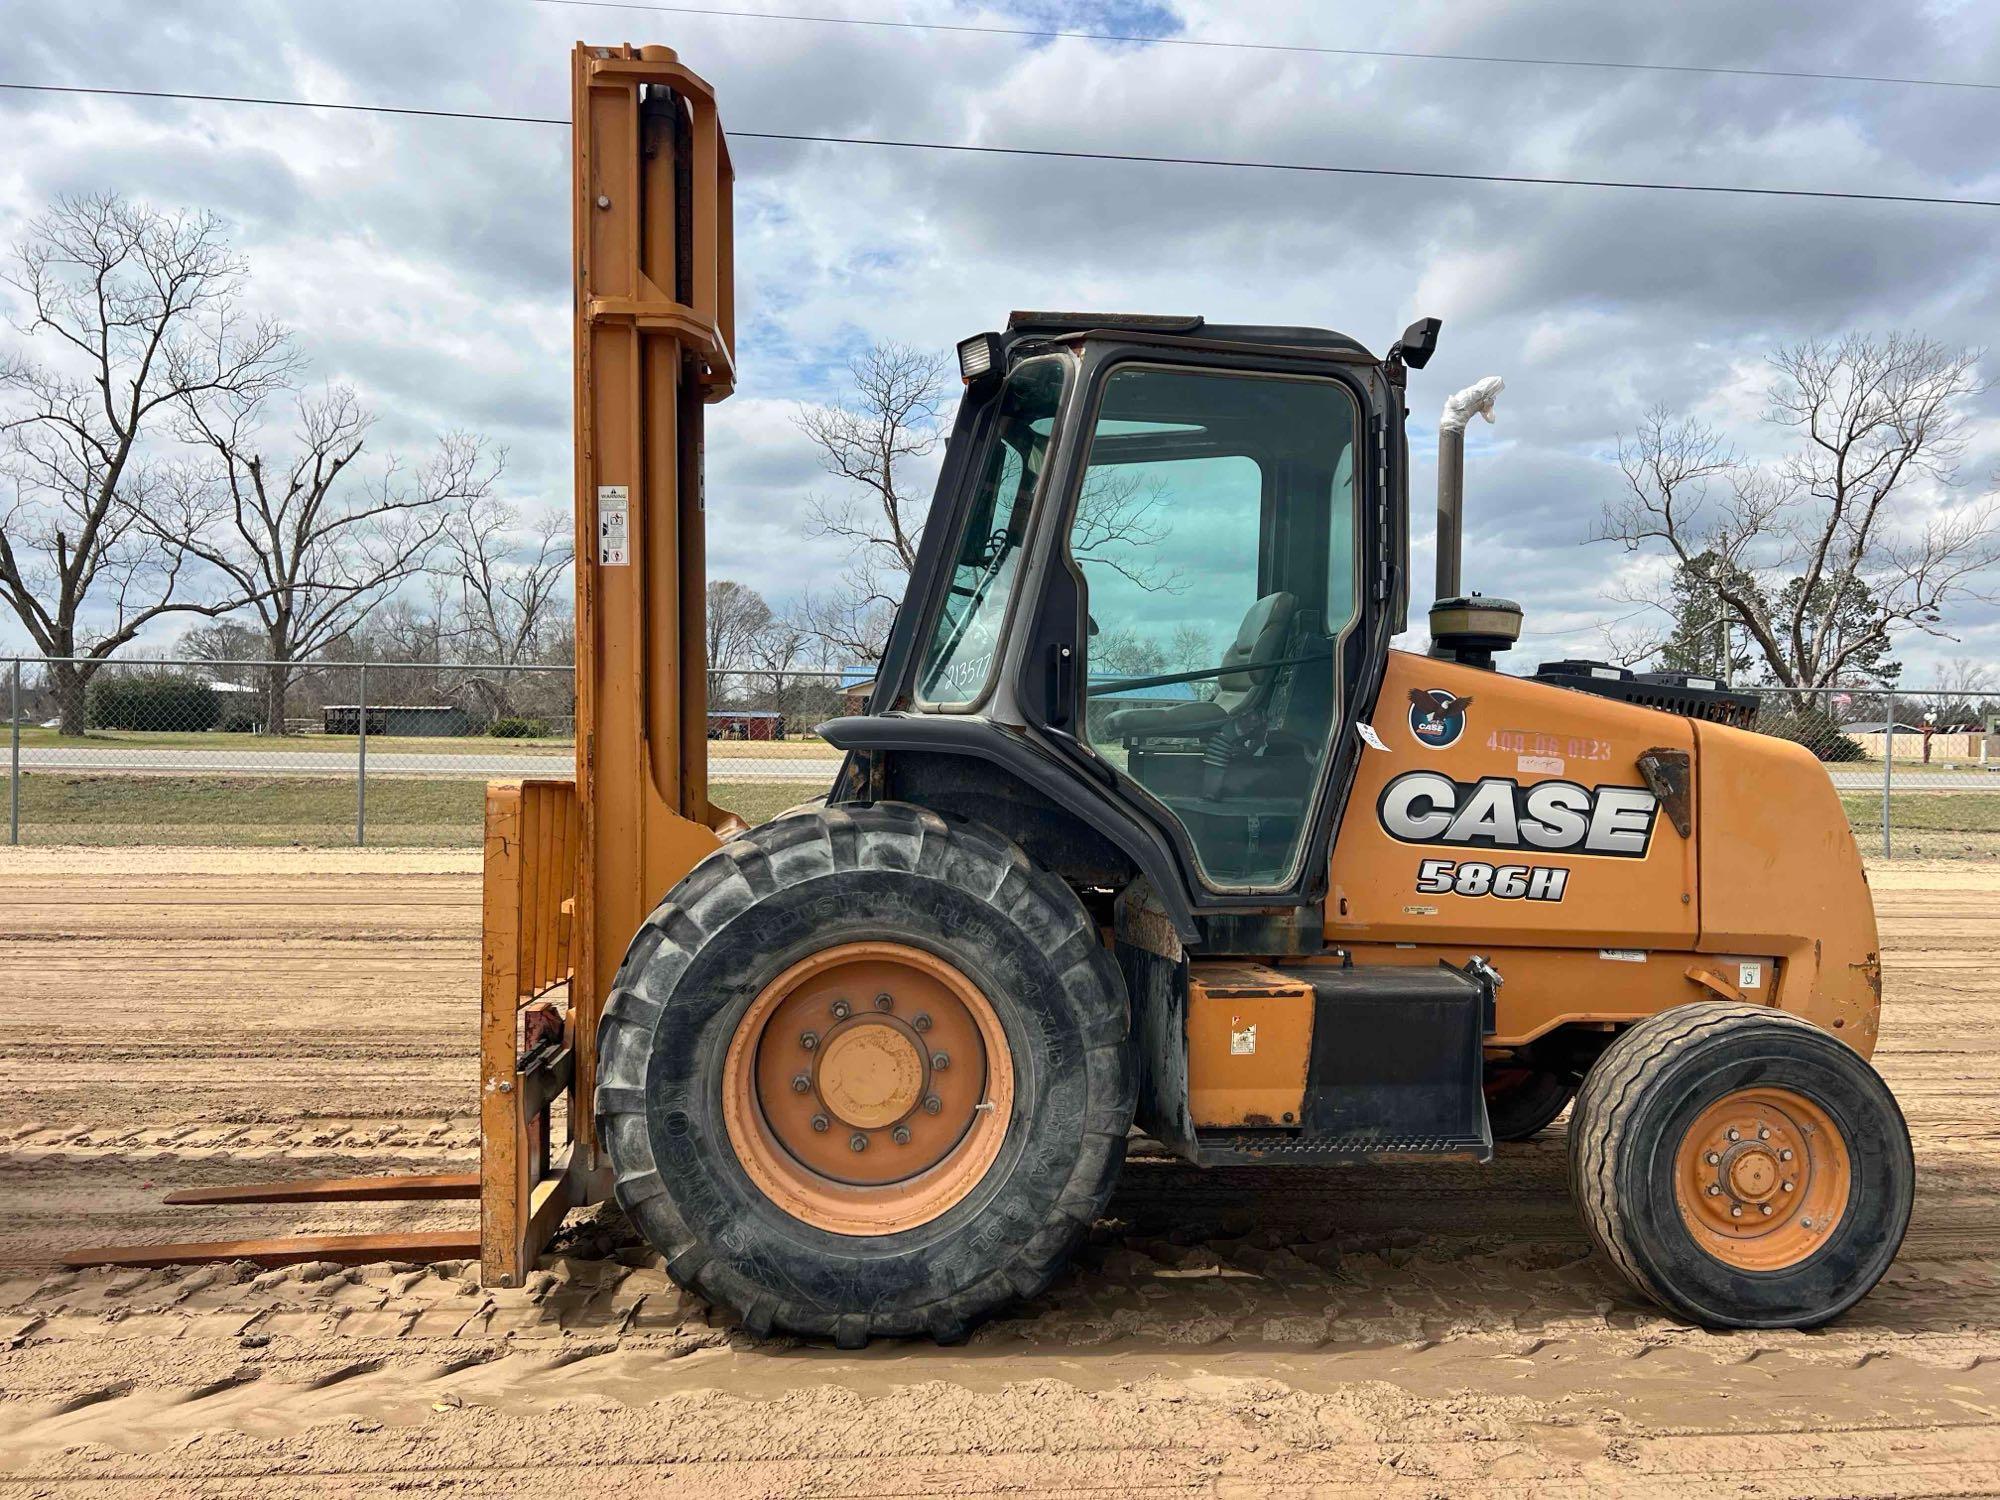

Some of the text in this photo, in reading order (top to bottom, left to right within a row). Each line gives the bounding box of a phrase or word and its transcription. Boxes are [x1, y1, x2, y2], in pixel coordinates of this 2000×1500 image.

[945, 653, 991, 690] 213577
[1418, 723, 1444, 732] CASE
[1382, 776, 1658, 853] CASE
[1417, 860, 1569, 901] 586H
